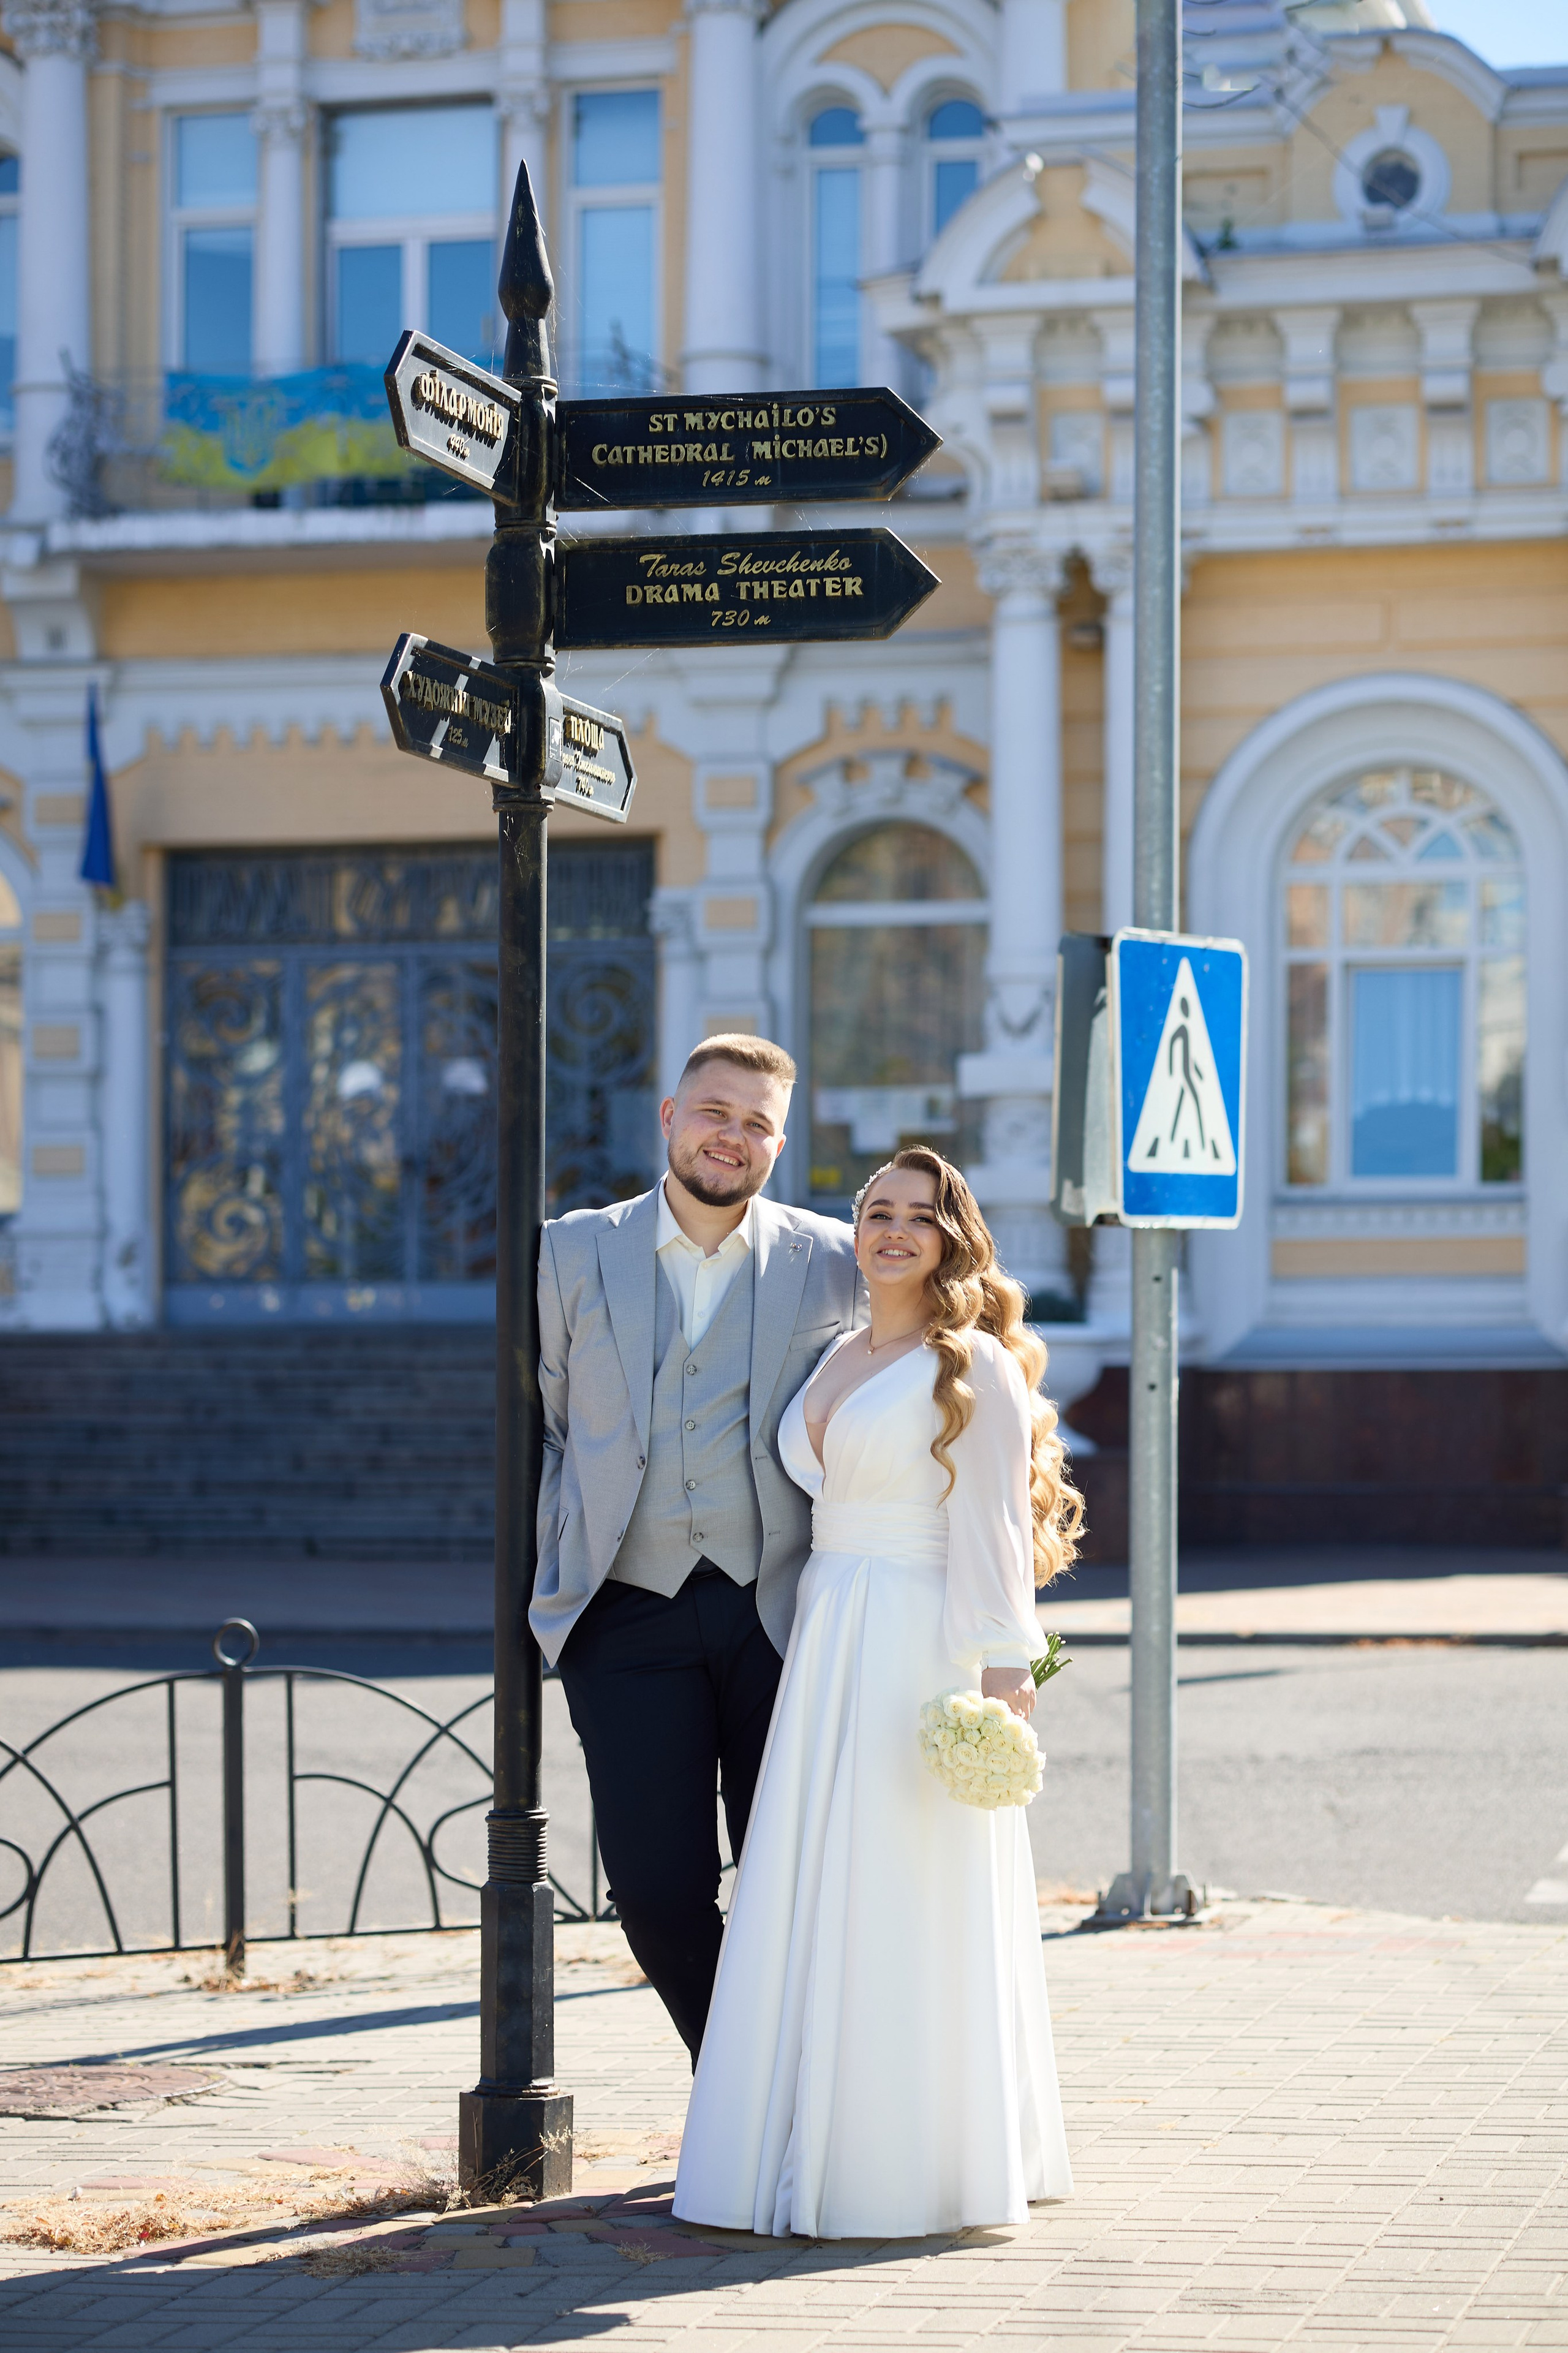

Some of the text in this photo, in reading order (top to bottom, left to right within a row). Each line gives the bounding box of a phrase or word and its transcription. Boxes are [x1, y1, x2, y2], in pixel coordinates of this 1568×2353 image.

[648, 414, 678, 432] ST
[592, 442, 734, 465] CATHEDRAL
[703, 469, 750, 487] 1415
[639, 549, 853, 578] Taras Shevchenko
[626, 576, 864, 605] DRAMA THEATER
[711, 609, 750, 627] 730
